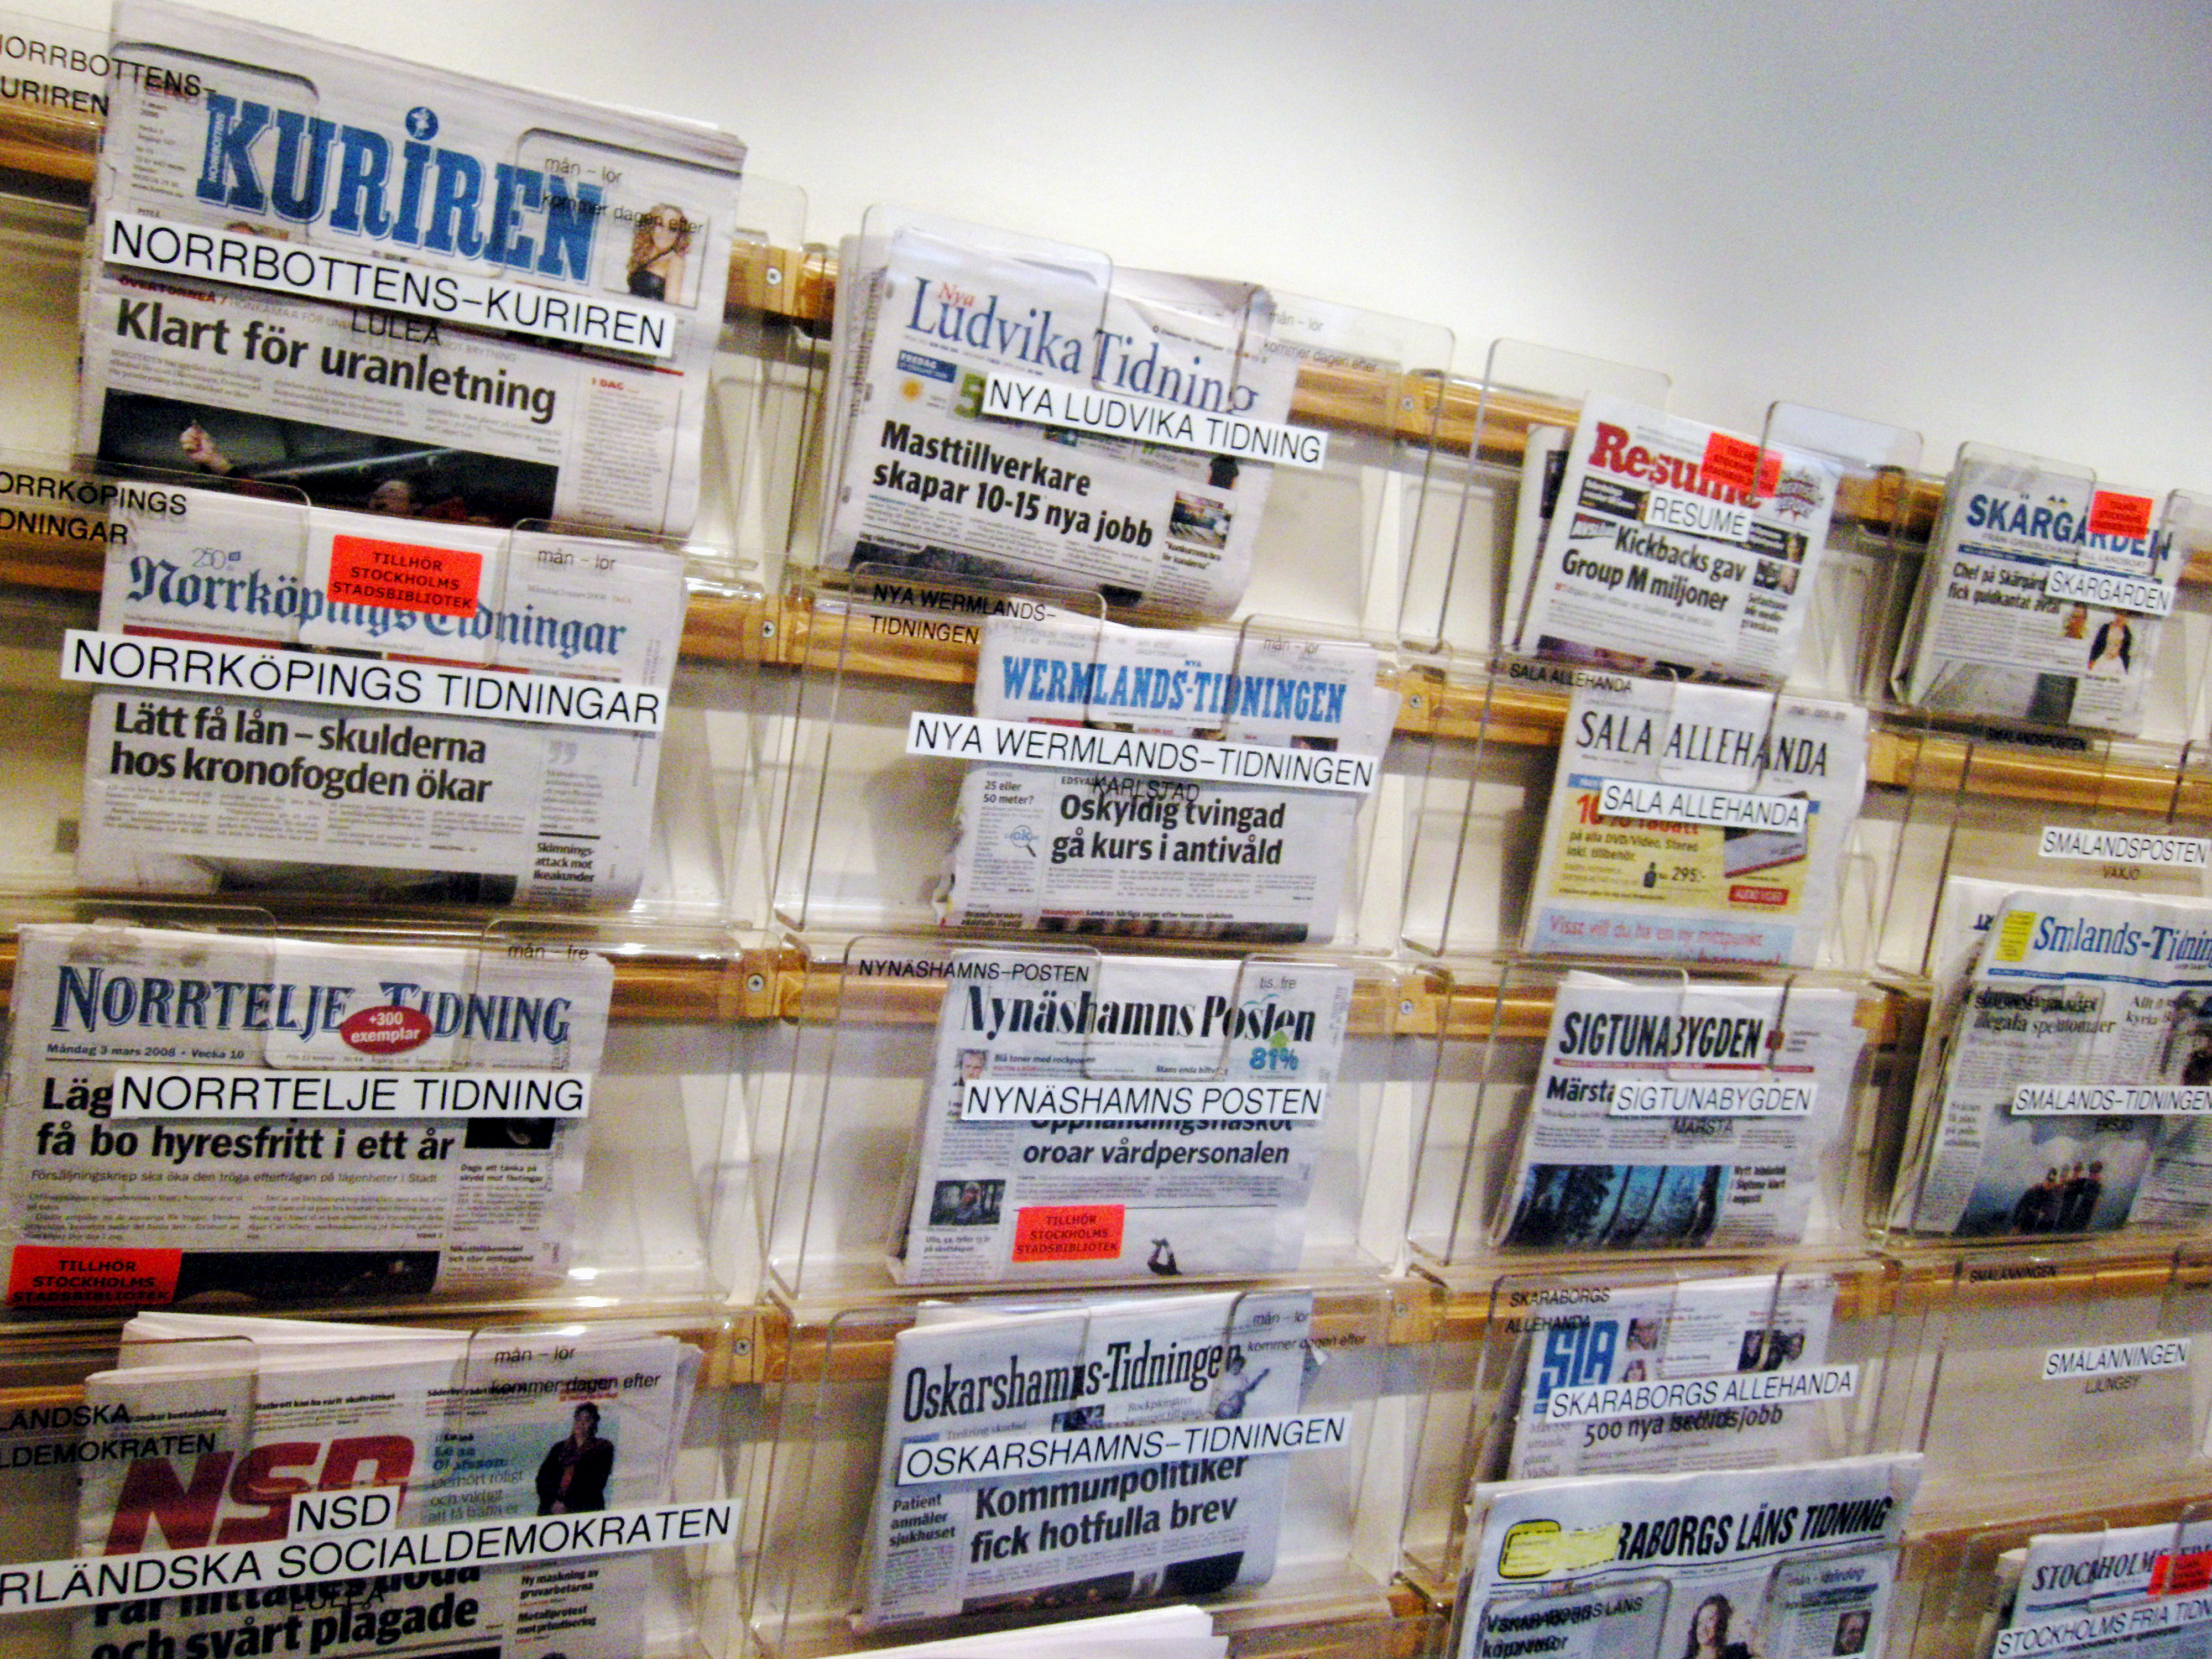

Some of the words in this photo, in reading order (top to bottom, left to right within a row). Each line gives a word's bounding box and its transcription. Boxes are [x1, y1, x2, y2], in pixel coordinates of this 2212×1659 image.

[112, 220, 665, 349] NORRBOTTENS-KURIREN
[940, 282, 975, 308] Nya
[117, 298, 230, 356] Klart
[243, 319, 308, 369] för
[320, 346, 556, 424] uranletning
[906, 276, 1082, 375] Ludvika
[1092, 327, 1259, 415] Tidning
[990, 379, 1053, 417] NYA
[1065, 393, 1194, 441] LUDVIKA
[1206, 418, 1320, 462] TIDNING
[880, 420, 1092, 496] Masttillverkare
[1588, 422, 1762, 509] Resum
[872, 460, 969, 504] skapar
[975, 482, 1039, 522] 10-15
[1044, 504, 1091, 535] nya
[1095, 511, 1154, 548] jobb
[1651, 496, 1747, 537] RESUMÉ
[373, 551, 443, 571] TILLHÖR
[1615, 525, 1709, 573] Kickbacks
[1714, 559, 1749, 582] gav
[333, 582, 473, 609] STADSBIBLIOTEK
[351, 567, 460, 591] STOCKHOLMS
[873, 583, 914, 604] NYA
[1562, 549, 1624, 590] Group
[1626, 565, 1648, 592] M
[1650, 574, 1730, 612] miljoner
[870, 615, 980, 645] TIDNINGEN
[74, 639, 421, 703] NORRKÖPINGS
[437, 674, 660, 724] TIDNINGAR
[1002, 655, 1347, 723] WERMLANDS-TIDNINGEN
[114, 702, 189, 738] Lätt
[195, 706, 227, 742] få
[235, 708, 288, 746] lån
[319, 719, 486, 763] skulderna
[1576, 711, 1652, 756] SALA
[1662, 722, 1827, 776] ALLEHANDA
[111, 742, 176, 778] hos
[182, 748, 408, 800] kronofogden
[416, 769, 493, 803] ökar
[915, 720, 982, 753] NYA
[996, 726, 1375, 787] WERMLANDS-TIDNINGEN
[983, 794, 997, 804] 50
[999, 795, 1035, 806] meter?
[999, 780, 1021, 791] eller
[1060, 795, 1180, 830] Oskyldig
[1185, 799, 1286, 833] tvingad
[1603, 785, 1662, 816] SALA
[1669, 792, 1800, 828] ALLEHANDA
[1051, 827, 1084, 863] gå
[1092, 832, 1152, 859] kurs
[1160, 833, 1168, 860] i
[1173, 832, 1283, 865] antivåld
[858, 959, 1089, 982] NYNÄSHAMNS-POSTEN
[51, 965, 354, 1042] NORRTELJE
[380, 982, 573, 1045] TIDNING
[961, 985, 1195, 1040] Nynäshamns
[1201, 995, 1316, 1041] Posten
[46, 1043, 96, 1056] Måndag
[100, 1045, 108, 1055] 3
[112, 1047, 141, 1057] mars
[230, 1050, 244, 1060] 10
[351, 1027, 420, 1044] exemplar
[1559, 1012, 1764, 1058] SIGTUNABYGDEN
[123, 1076, 396, 1112] NORRTELJE
[414, 1079, 584, 1111] TIDNING
[968, 1085, 1192, 1115] NYNÄSHAMNS
[1202, 1087, 1321, 1114] POSTEN
[1617, 1086, 1812, 1110] SIGTUNABYGDEN
[37, 1121, 75, 1156] få
[90, 1125, 138, 1157] bo
[152, 1124, 324, 1164] hyresfritt
[336, 1129, 346, 1159] i
[357, 1129, 409, 1160] ett
[418, 1128, 455, 1161] år
[1023, 1145, 1094, 1164] oroar
[1102, 1137, 1290, 1169] vårdpersonalen
[194, 1171, 215, 1182] den
[1030, 1228, 1108, 1240] STOCKHOLMS
[1046, 1214, 1096, 1225] TILLHÖR
[58, 1259, 137, 1272] TILLHÖR
[1016, 1241, 1118, 1255] STADSBIBLIOTEK
[32, 1276, 156, 1288] STOCKHOLMS
[1552, 1380, 1718, 1418] SKARABORGS
[1723, 1371, 1851, 1404] ALLEHANDA
[907, 1417, 1344, 1477] OSKARSHAMNS-TIDNINGEN
[1584, 1423, 1623, 1447] 500
[1627, 1416, 1663, 1443] nya
[893, 1493, 942, 1512] Patient
[975, 1455, 1249, 1520] Kommunpolitiker
[297, 1493, 391, 1532] NSD
[891, 1511, 948, 1530] anmäler
[970, 1525, 1031, 1563] fick
[1039, 1505, 1161, 1551] hotfulla
[1170, 1496, 1238, 1531] brev
[1618, 1510, 1731, 1562] RABORGS
[1736, 1502, 1797, 1549] LÄNS
[1800, 1496, 1892, 1542] TIDNING
[0, 1550, 262, 1605] RLÄNDSKA
[278, 1506, 731, 1579] SOCIALDEMOKRATEN
[889, 1526, 955, 1547] sjukhuset
[91, 1629, 176, 1659] och
[185, 1615, 302, 1656] svårt
[309, 1593, 479, 1655] plågade
[1999, 1613, 2126, 1655] STOCKHOLMS
